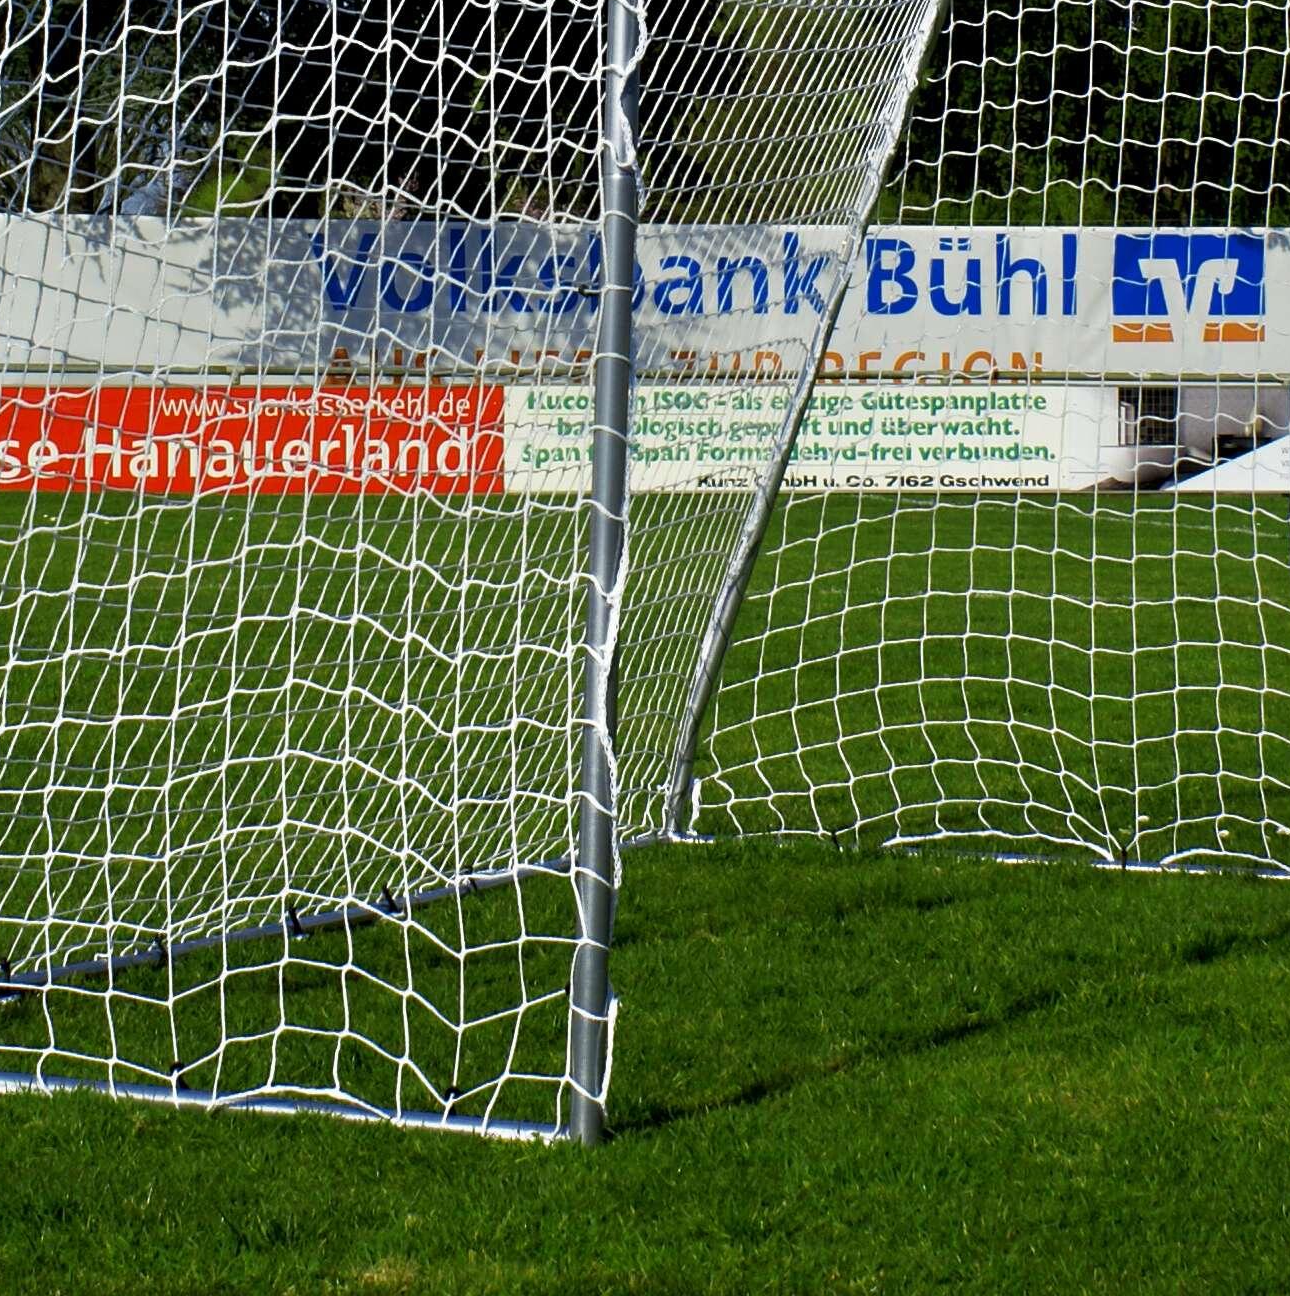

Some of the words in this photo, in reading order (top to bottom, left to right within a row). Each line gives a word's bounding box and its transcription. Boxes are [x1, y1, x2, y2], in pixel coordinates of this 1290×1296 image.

[865, 233, 1078, 316] Bühl
[731, 392, 764, 410] als
[769, 392, 854, 415] eizige
[861, 391, 1047, 415] Gütespanplatte
[729, 418, 822, 442] geprft
[827, 417, 874, 435] und
[84, 424, 468, 478] Hanauerland
[697, 442, 912, 466] Formadehyd-frei
[918, 443, 1056, 461] verbunden.
[846, 475, 879, 487] Co.
[884, 475, 934, 487] 7162
[939, 474, 1050, 488] Gschwend
